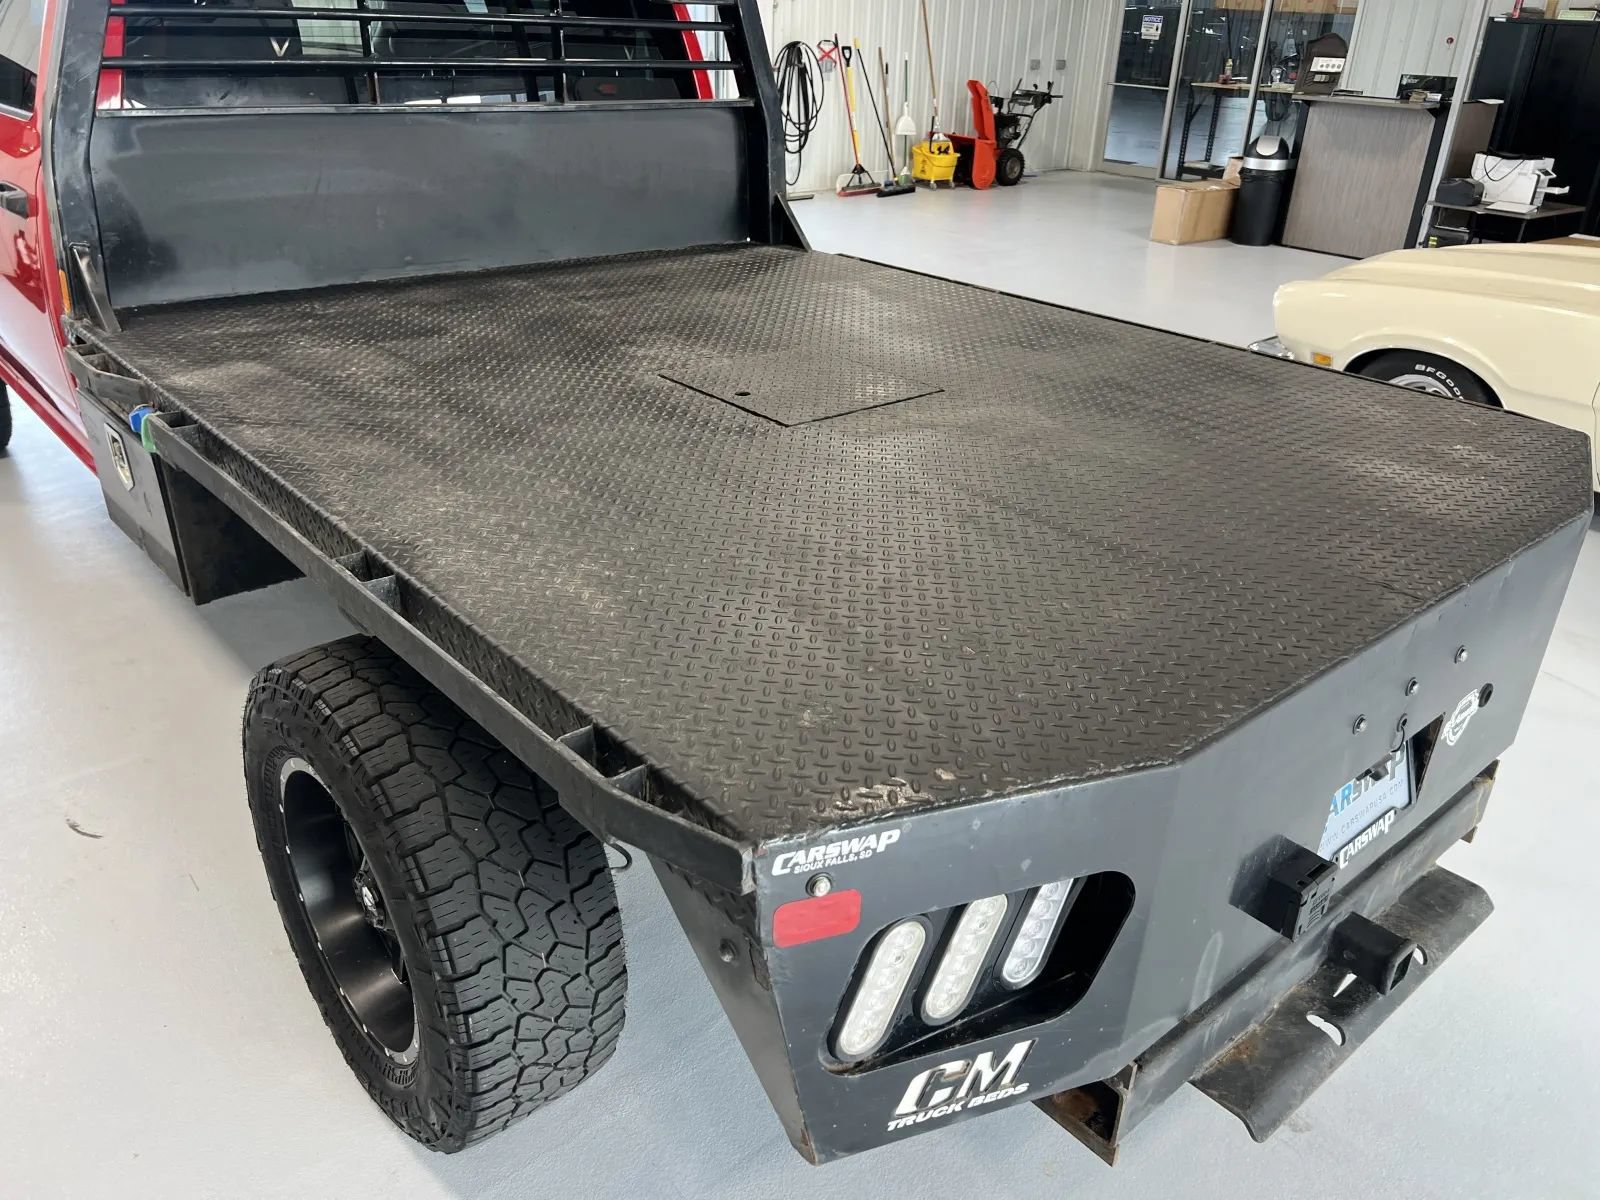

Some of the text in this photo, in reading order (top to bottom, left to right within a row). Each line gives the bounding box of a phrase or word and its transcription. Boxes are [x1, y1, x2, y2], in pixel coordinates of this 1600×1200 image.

[771, 829, 901, 876] CARSWAP
[793, 849, 873, 874] SIOUX FALLS, SD
[1340, 809, 1396, 869] CARSWAP
[894, 1038, 1035, 1117] CM
[887, 1082, 1030, 1131] TRUCK BEDS
